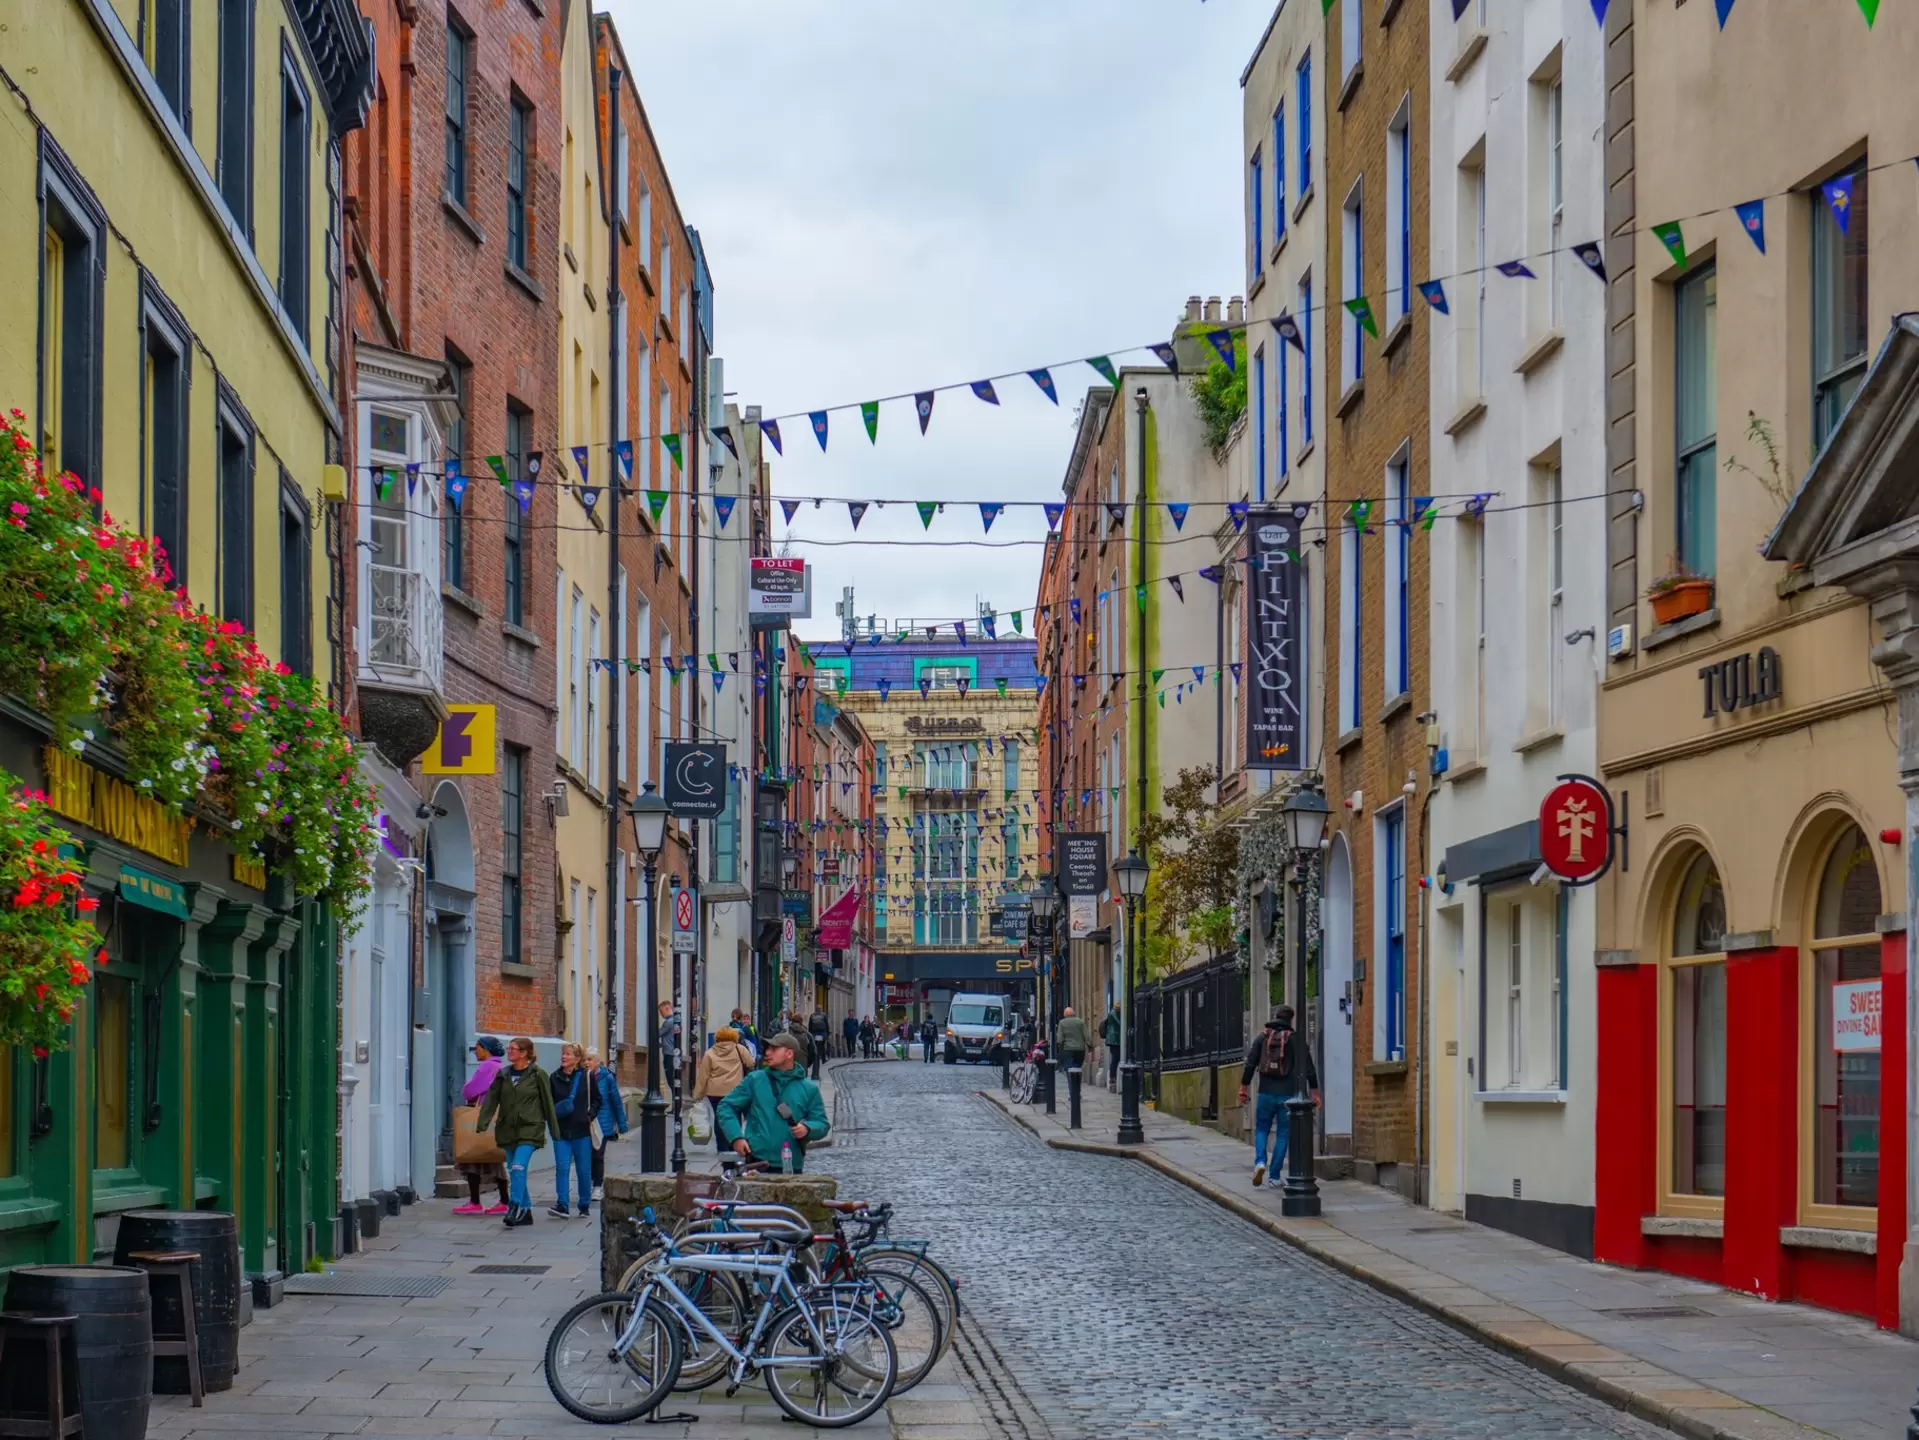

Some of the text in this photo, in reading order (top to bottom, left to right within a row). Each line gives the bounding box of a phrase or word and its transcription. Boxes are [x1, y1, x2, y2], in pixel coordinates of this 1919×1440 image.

[761, 560, 794, 568] TO LET
[786, 577, 797, 585] Only
[1253, 551, 1297, 704] PINTXO
[1698, 646, 1781, 718] TULA
[1253, 724, 1277, 732] TAPAS
[672, 801, 717, 809] connector.ie
[1004, 919, 1018, 928] CAFÉ
[1850, 990, 1882, 1014] SWEE
[1837, 1018, 1863, 1033] DIVINE
